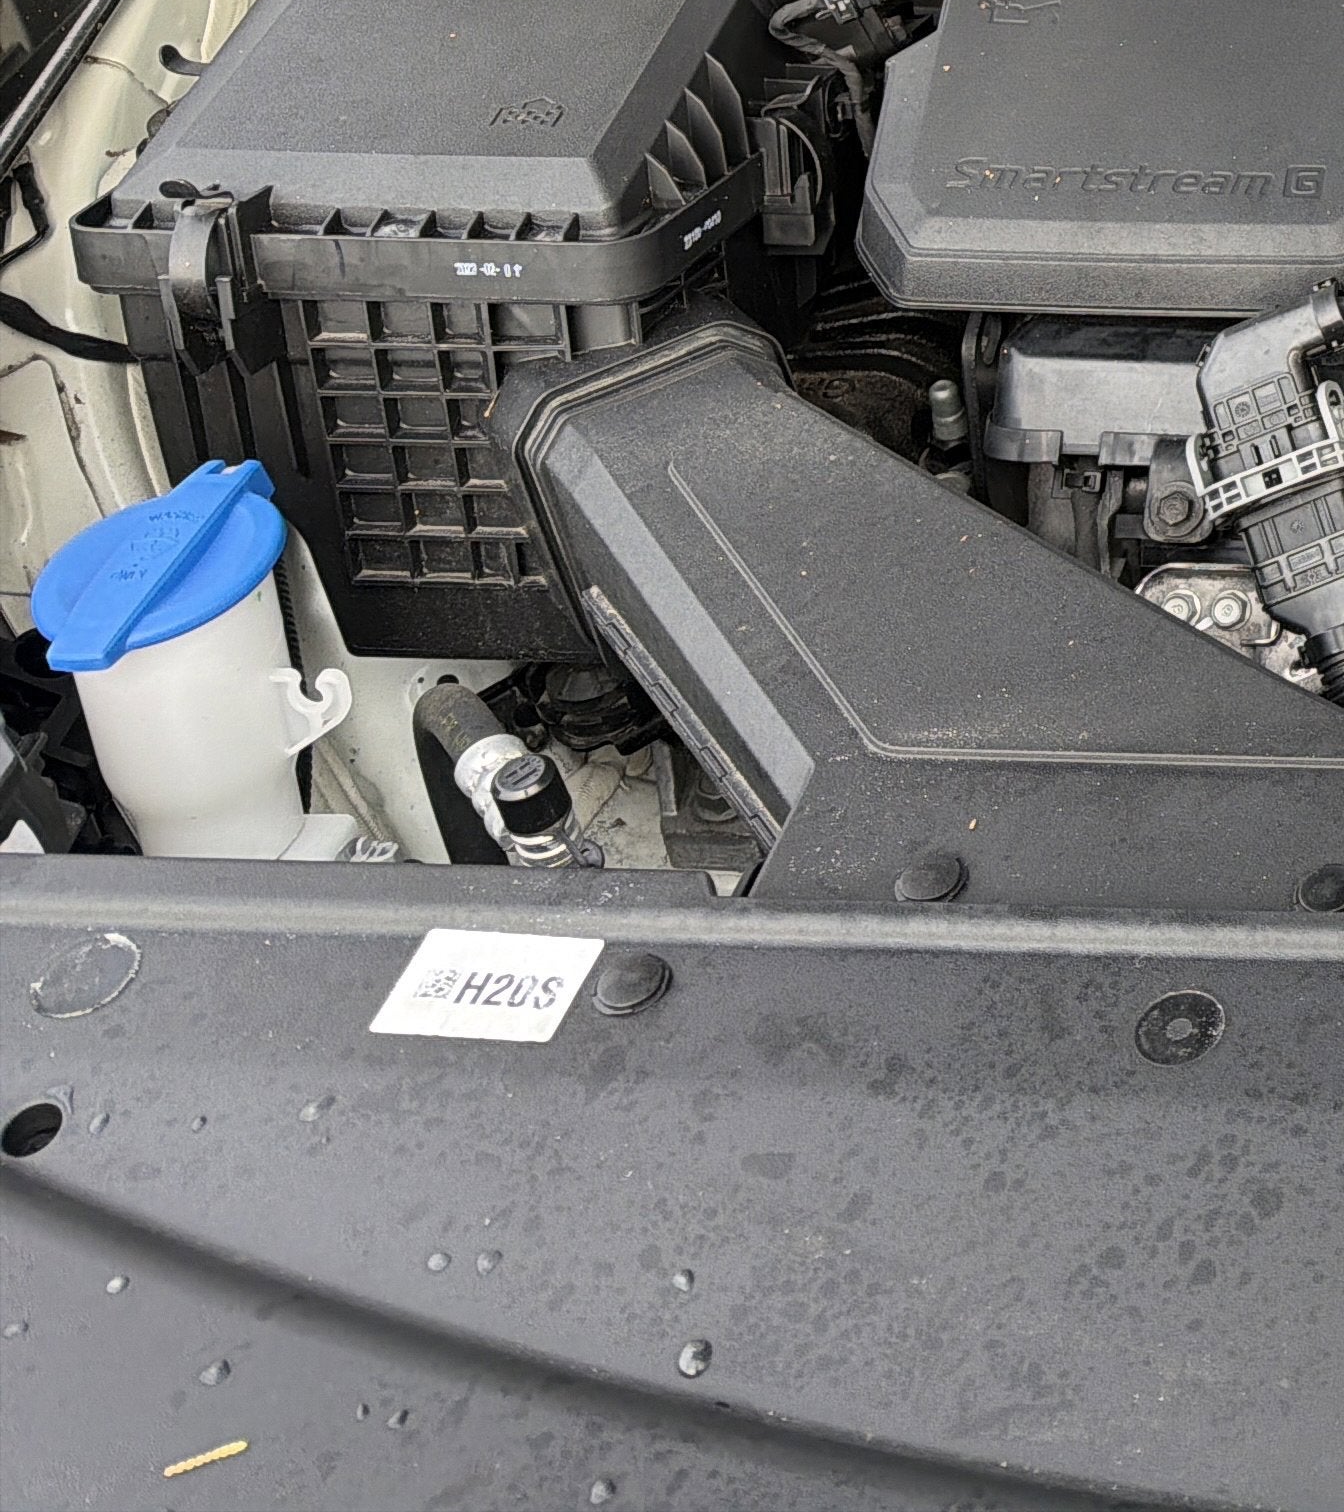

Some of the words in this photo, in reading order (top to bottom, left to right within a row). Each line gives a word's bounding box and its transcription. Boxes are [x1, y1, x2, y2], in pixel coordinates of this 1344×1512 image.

[946, 155, 1277, 198] Smartstream
[1282, 164, 1327, 199] G
[452, 970, 564, 1010] H20S
